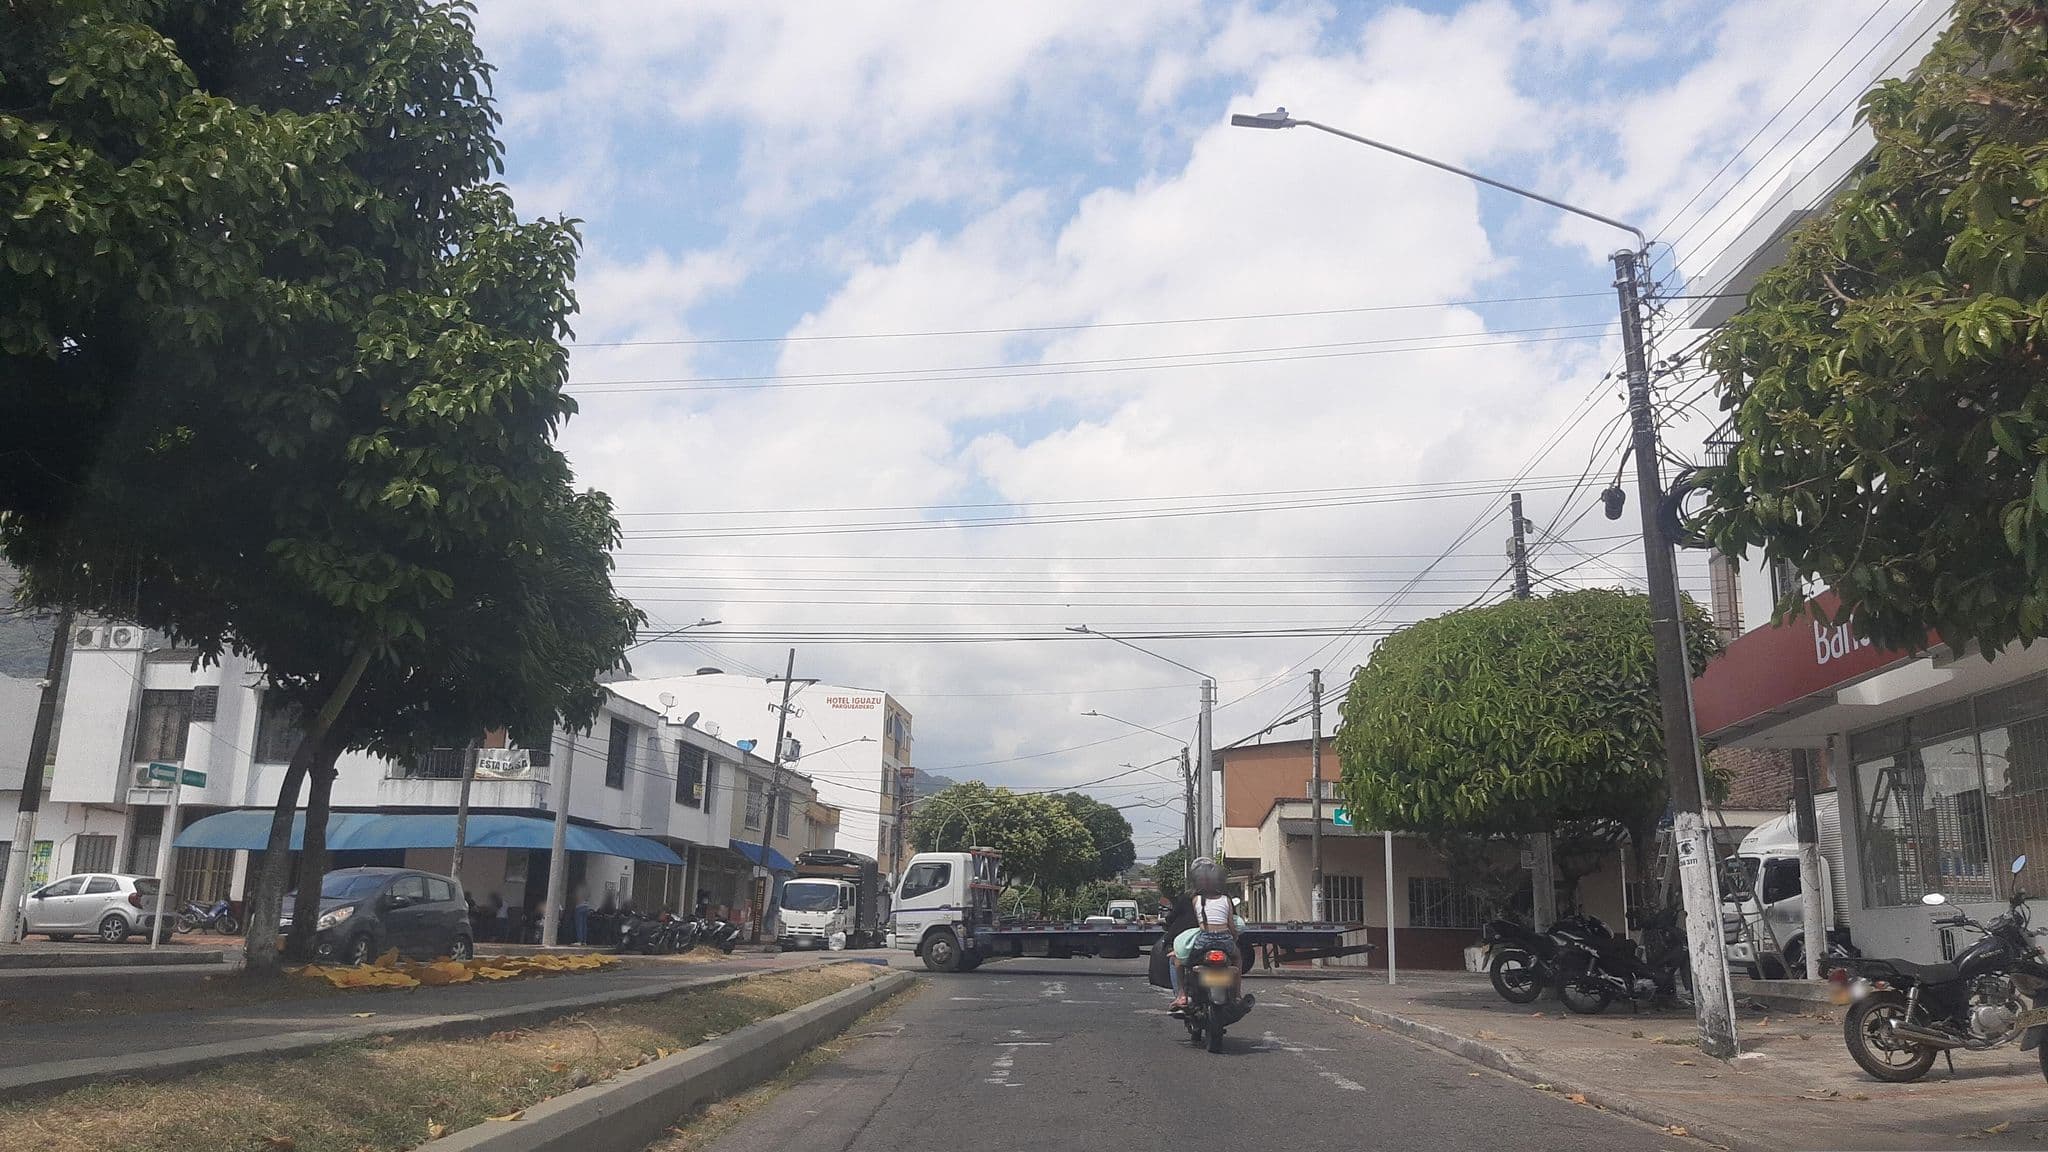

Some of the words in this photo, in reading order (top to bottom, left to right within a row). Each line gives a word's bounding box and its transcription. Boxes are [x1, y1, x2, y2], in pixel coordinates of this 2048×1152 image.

[826, 696, 850, 705] HOTEL
[480, 759, 501, 770] ESTA
[502, 759, 528, 771] CASA
